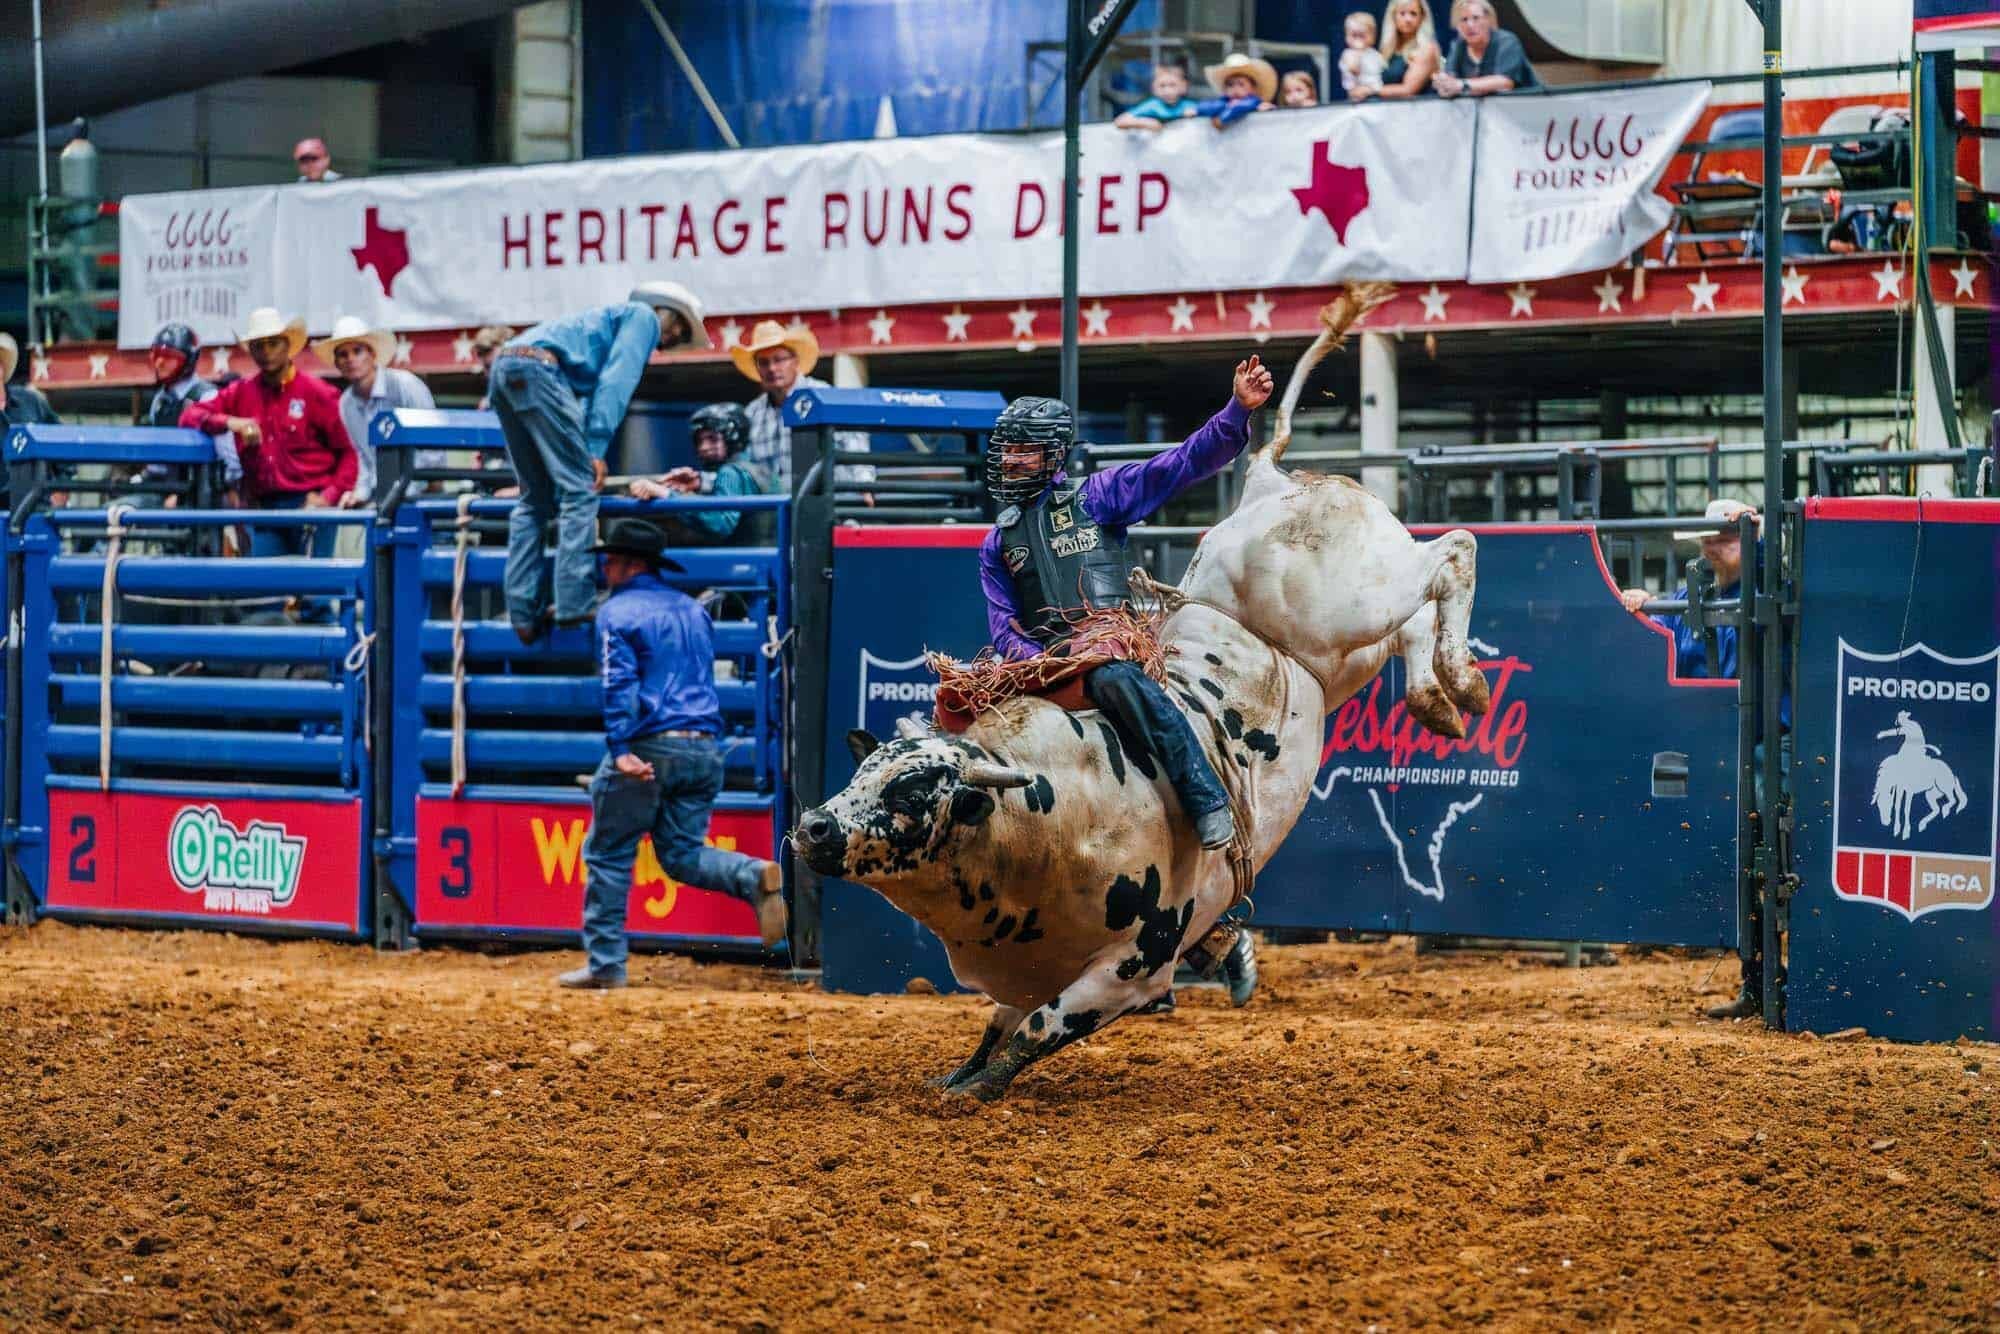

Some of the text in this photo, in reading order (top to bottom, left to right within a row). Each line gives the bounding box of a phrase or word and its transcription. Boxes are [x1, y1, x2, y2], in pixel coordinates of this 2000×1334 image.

[1545, 114, 1643, 162] 6666
[1514, 169, 1585, 190] FOUR
[503, 197, 788, 269] HERITAGE
[823, 184, 974, 249] RUNS
[1848, 676, 1990, 702] PRORODEO
[1353, 766, 1519, 787] CHAMPIONSHIP RODEO
[68, 815, 96, 883] 2
[176, 817, 295, 892] O'Reilly
[440, 826, 472, 899] 3
[1921, 871, 1984, 892] PRCA
